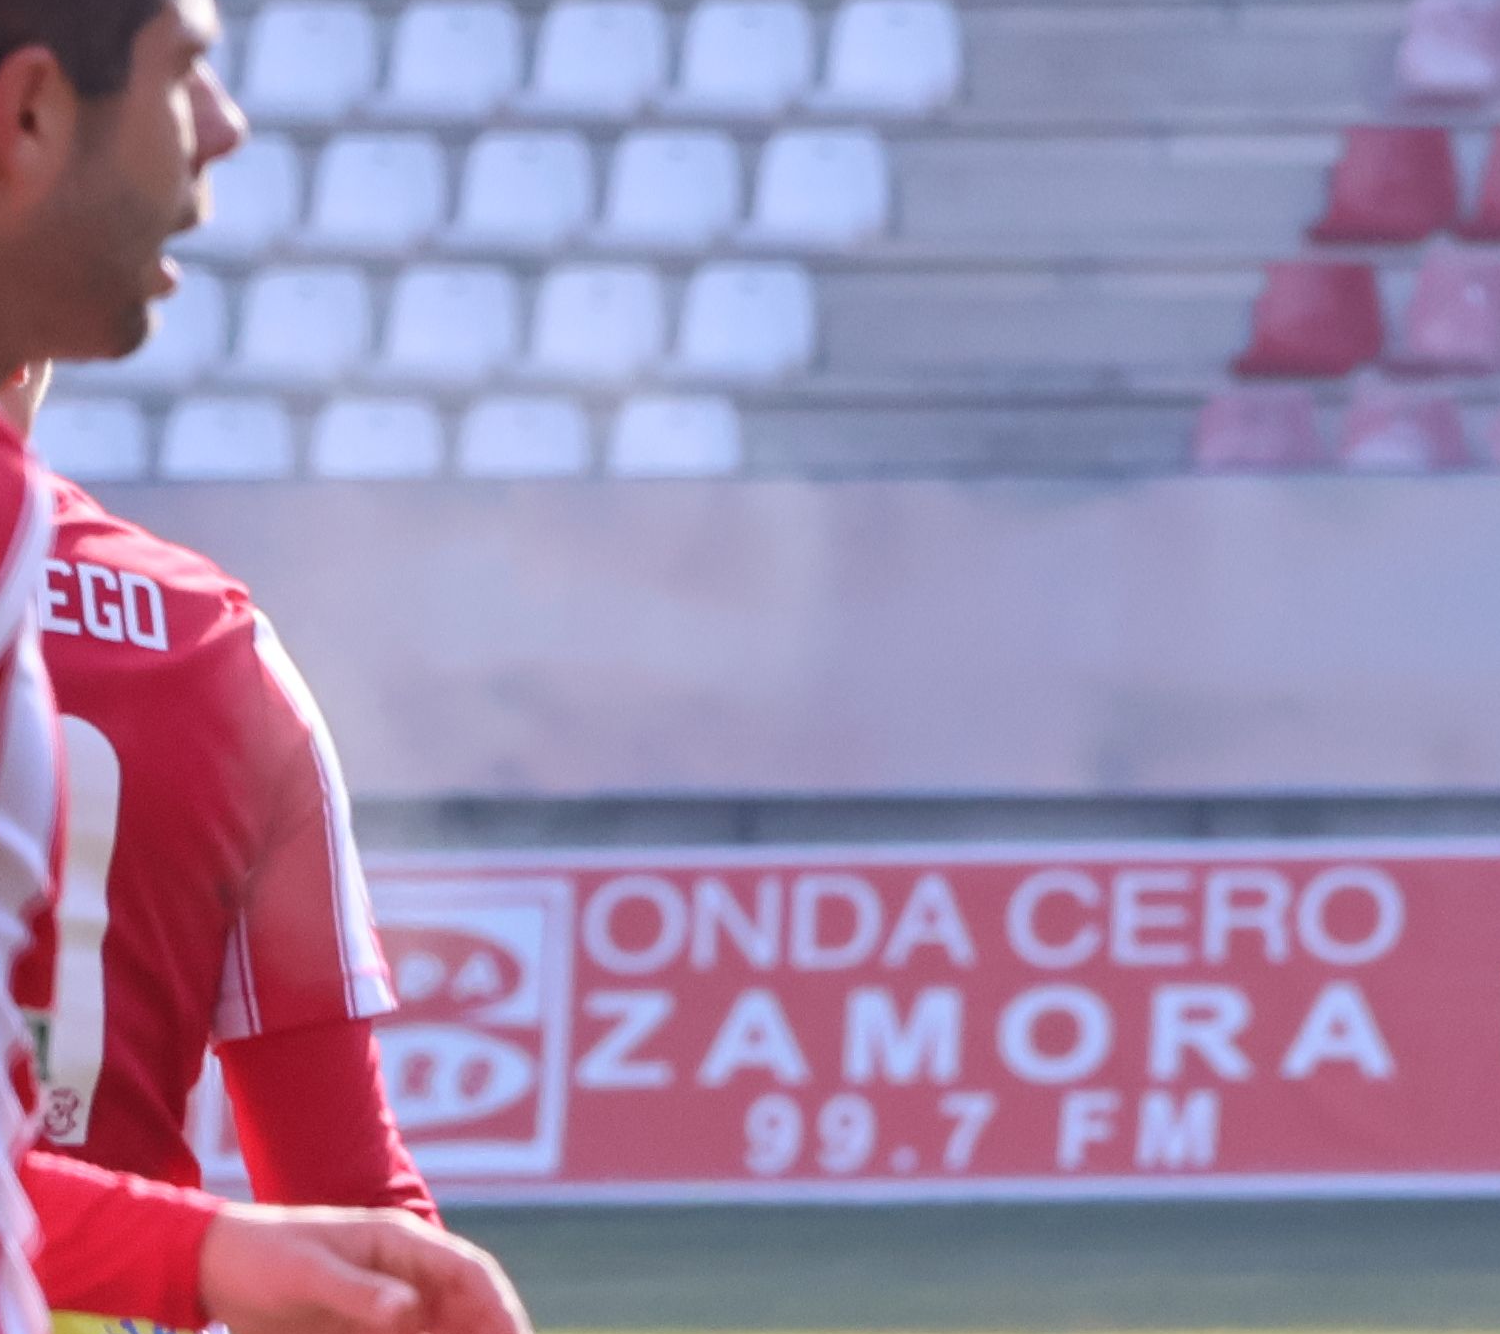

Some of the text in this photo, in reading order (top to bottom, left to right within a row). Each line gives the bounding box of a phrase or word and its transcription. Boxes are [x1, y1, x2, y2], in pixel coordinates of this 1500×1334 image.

[582, 867, 1405, 974] ONDA CERO
[575, 981, 1396, 1089] ZAMORA
[742, 1087, 1219, 1176] 99.7 FM
